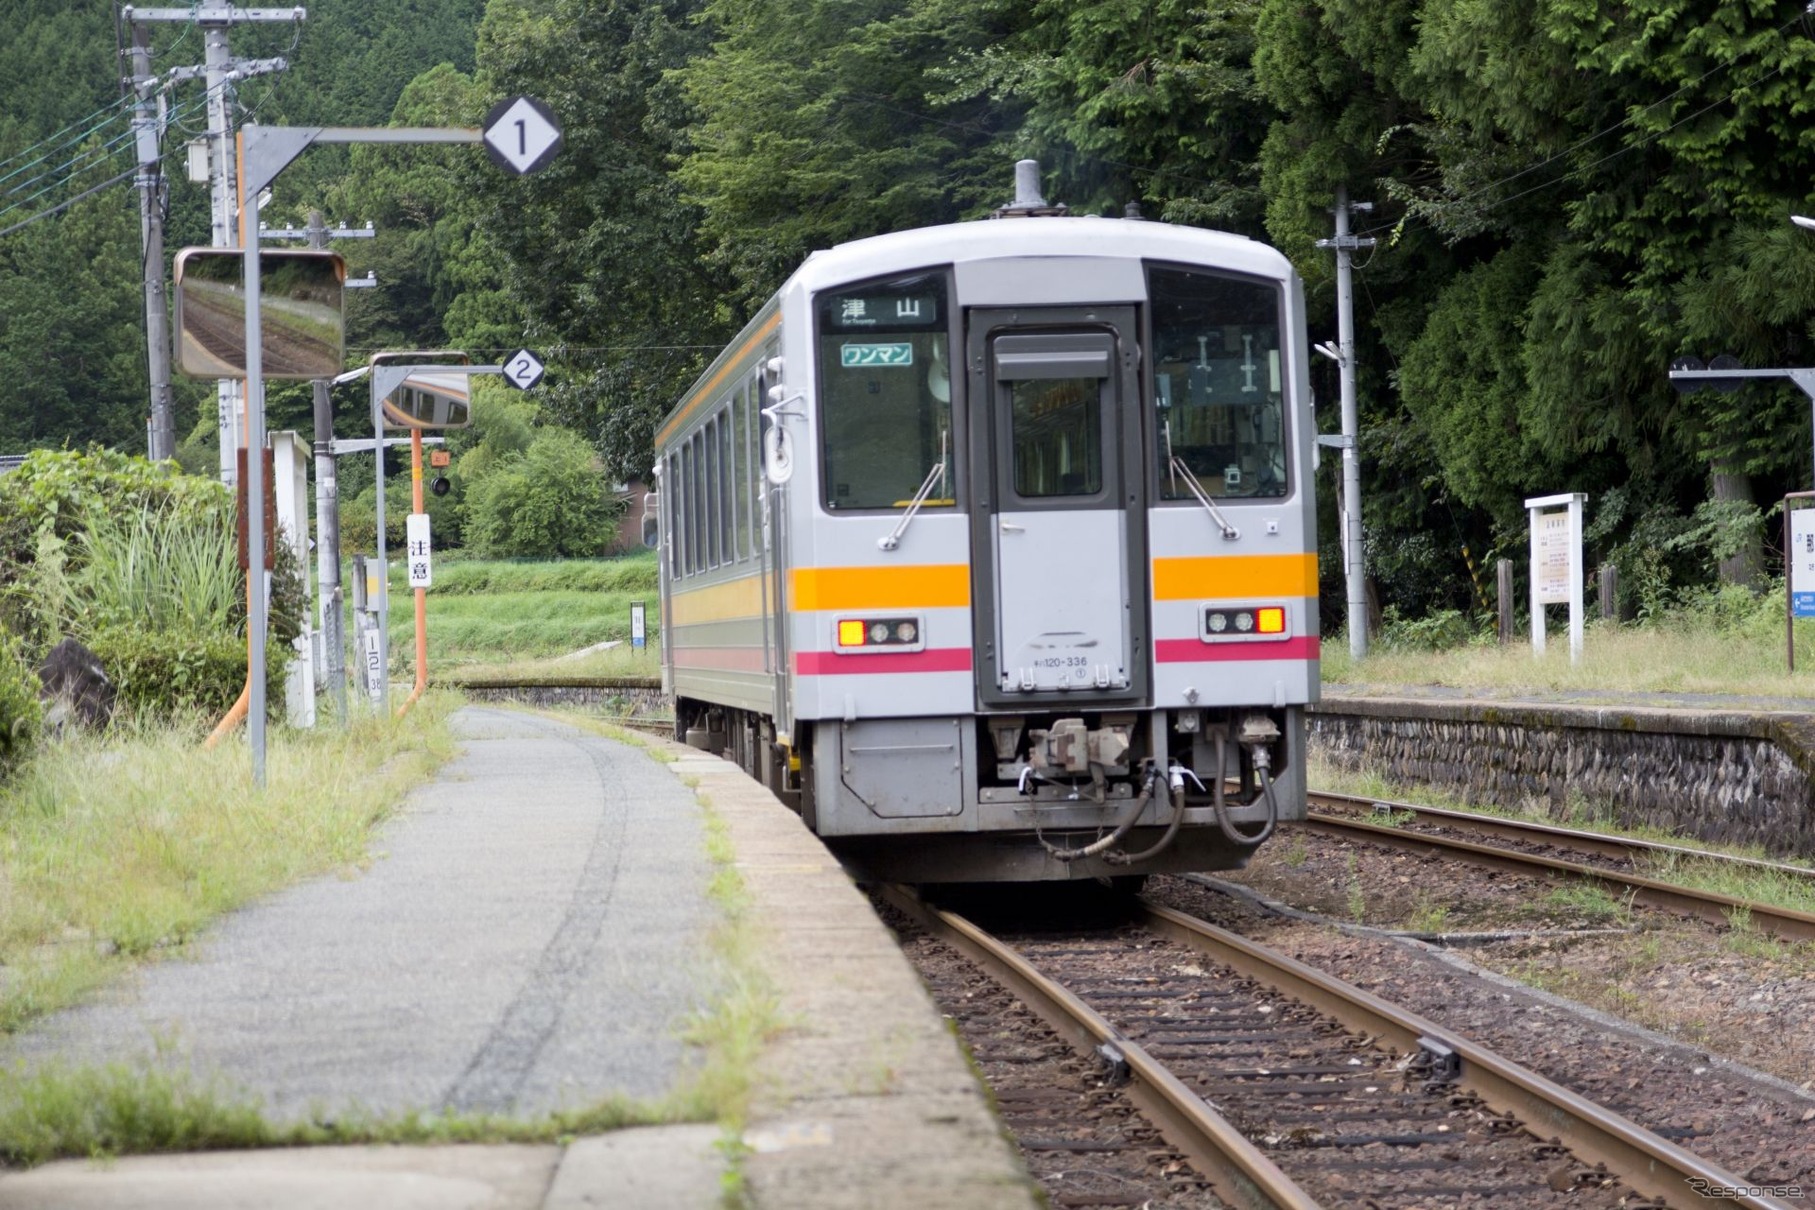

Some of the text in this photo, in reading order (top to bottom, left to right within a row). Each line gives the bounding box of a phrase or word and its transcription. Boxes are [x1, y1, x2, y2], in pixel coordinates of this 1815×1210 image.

[514, 118, 526, 155] 1
[842, 297, 919, 318] 津山
[845, 346, 909, 363] ワンマン
[516, 359, 531, 379] 2
[411, 541, 428, 579] 注意
